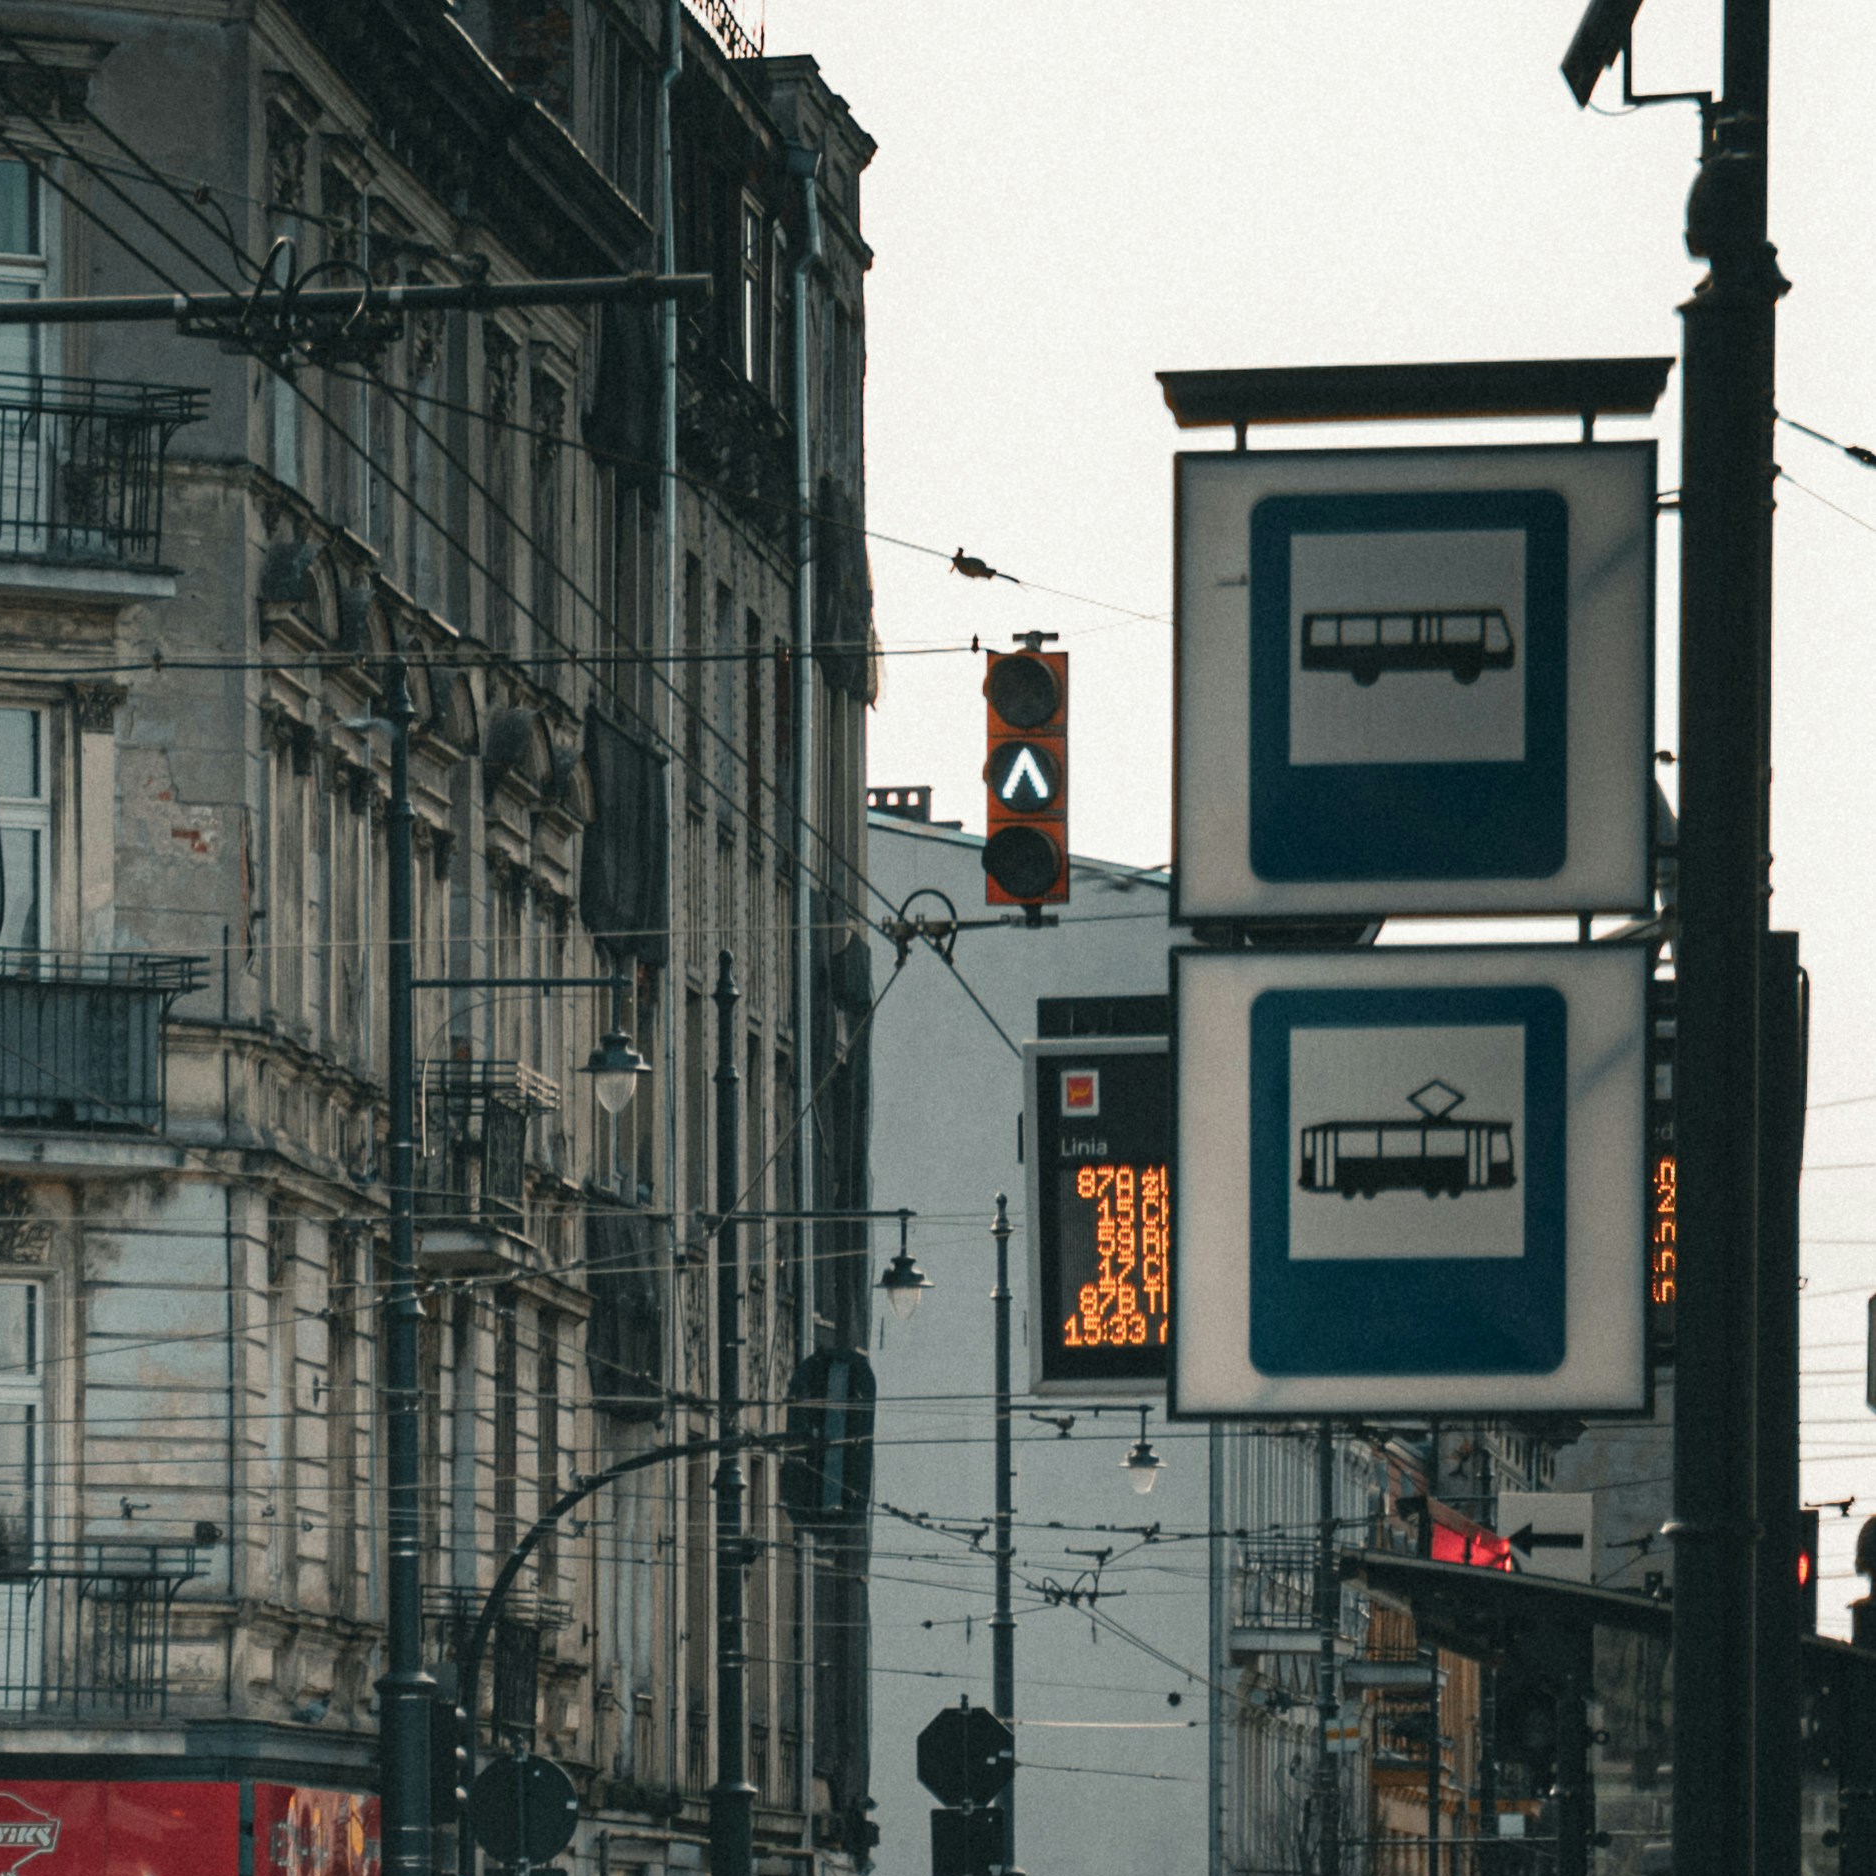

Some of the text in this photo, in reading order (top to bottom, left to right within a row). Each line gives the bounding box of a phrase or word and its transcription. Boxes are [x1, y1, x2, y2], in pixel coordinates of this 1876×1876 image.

[1061, 1137, 1108, 1157] Linia
[1099, 1255, 1136, 1286] 17
[1064, 1314, 1147, 1346] 15:33
